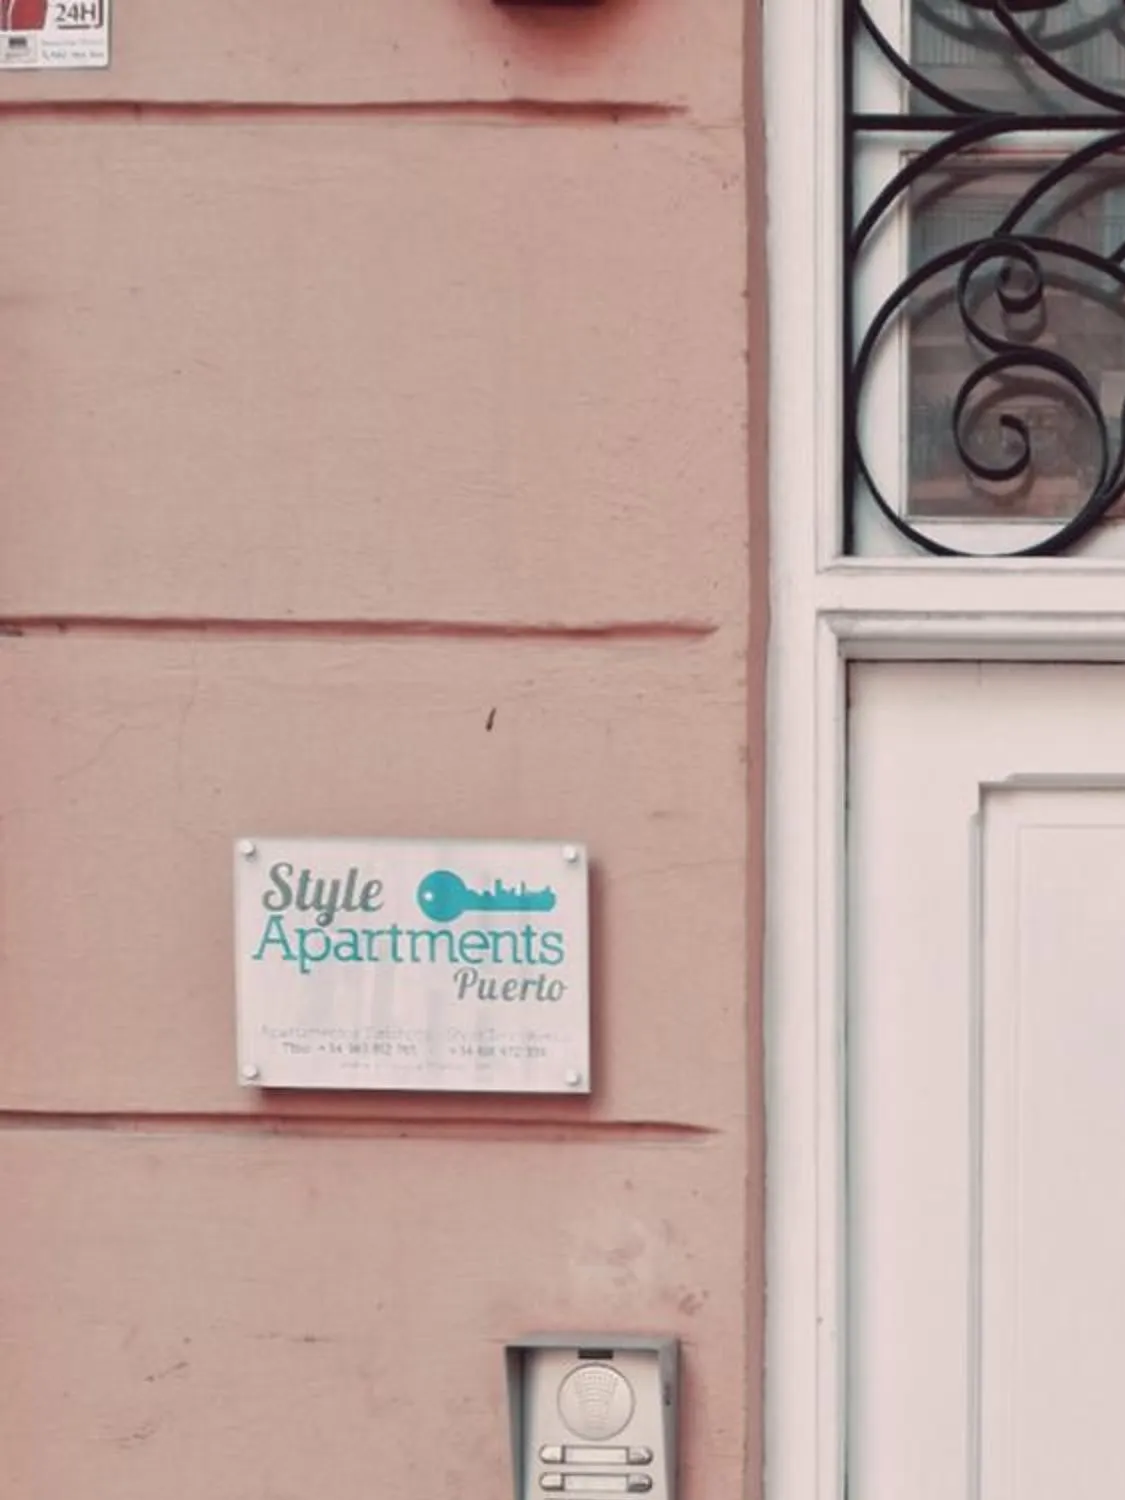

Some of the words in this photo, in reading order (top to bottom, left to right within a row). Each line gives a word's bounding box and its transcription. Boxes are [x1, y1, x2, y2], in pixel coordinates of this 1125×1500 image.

[54, 3, 97, 22] 24H
[262, 863, 384, 927] Style
[252, 915, 565, 974] Apartments
[453, 967, 568, 1002] Puerto
